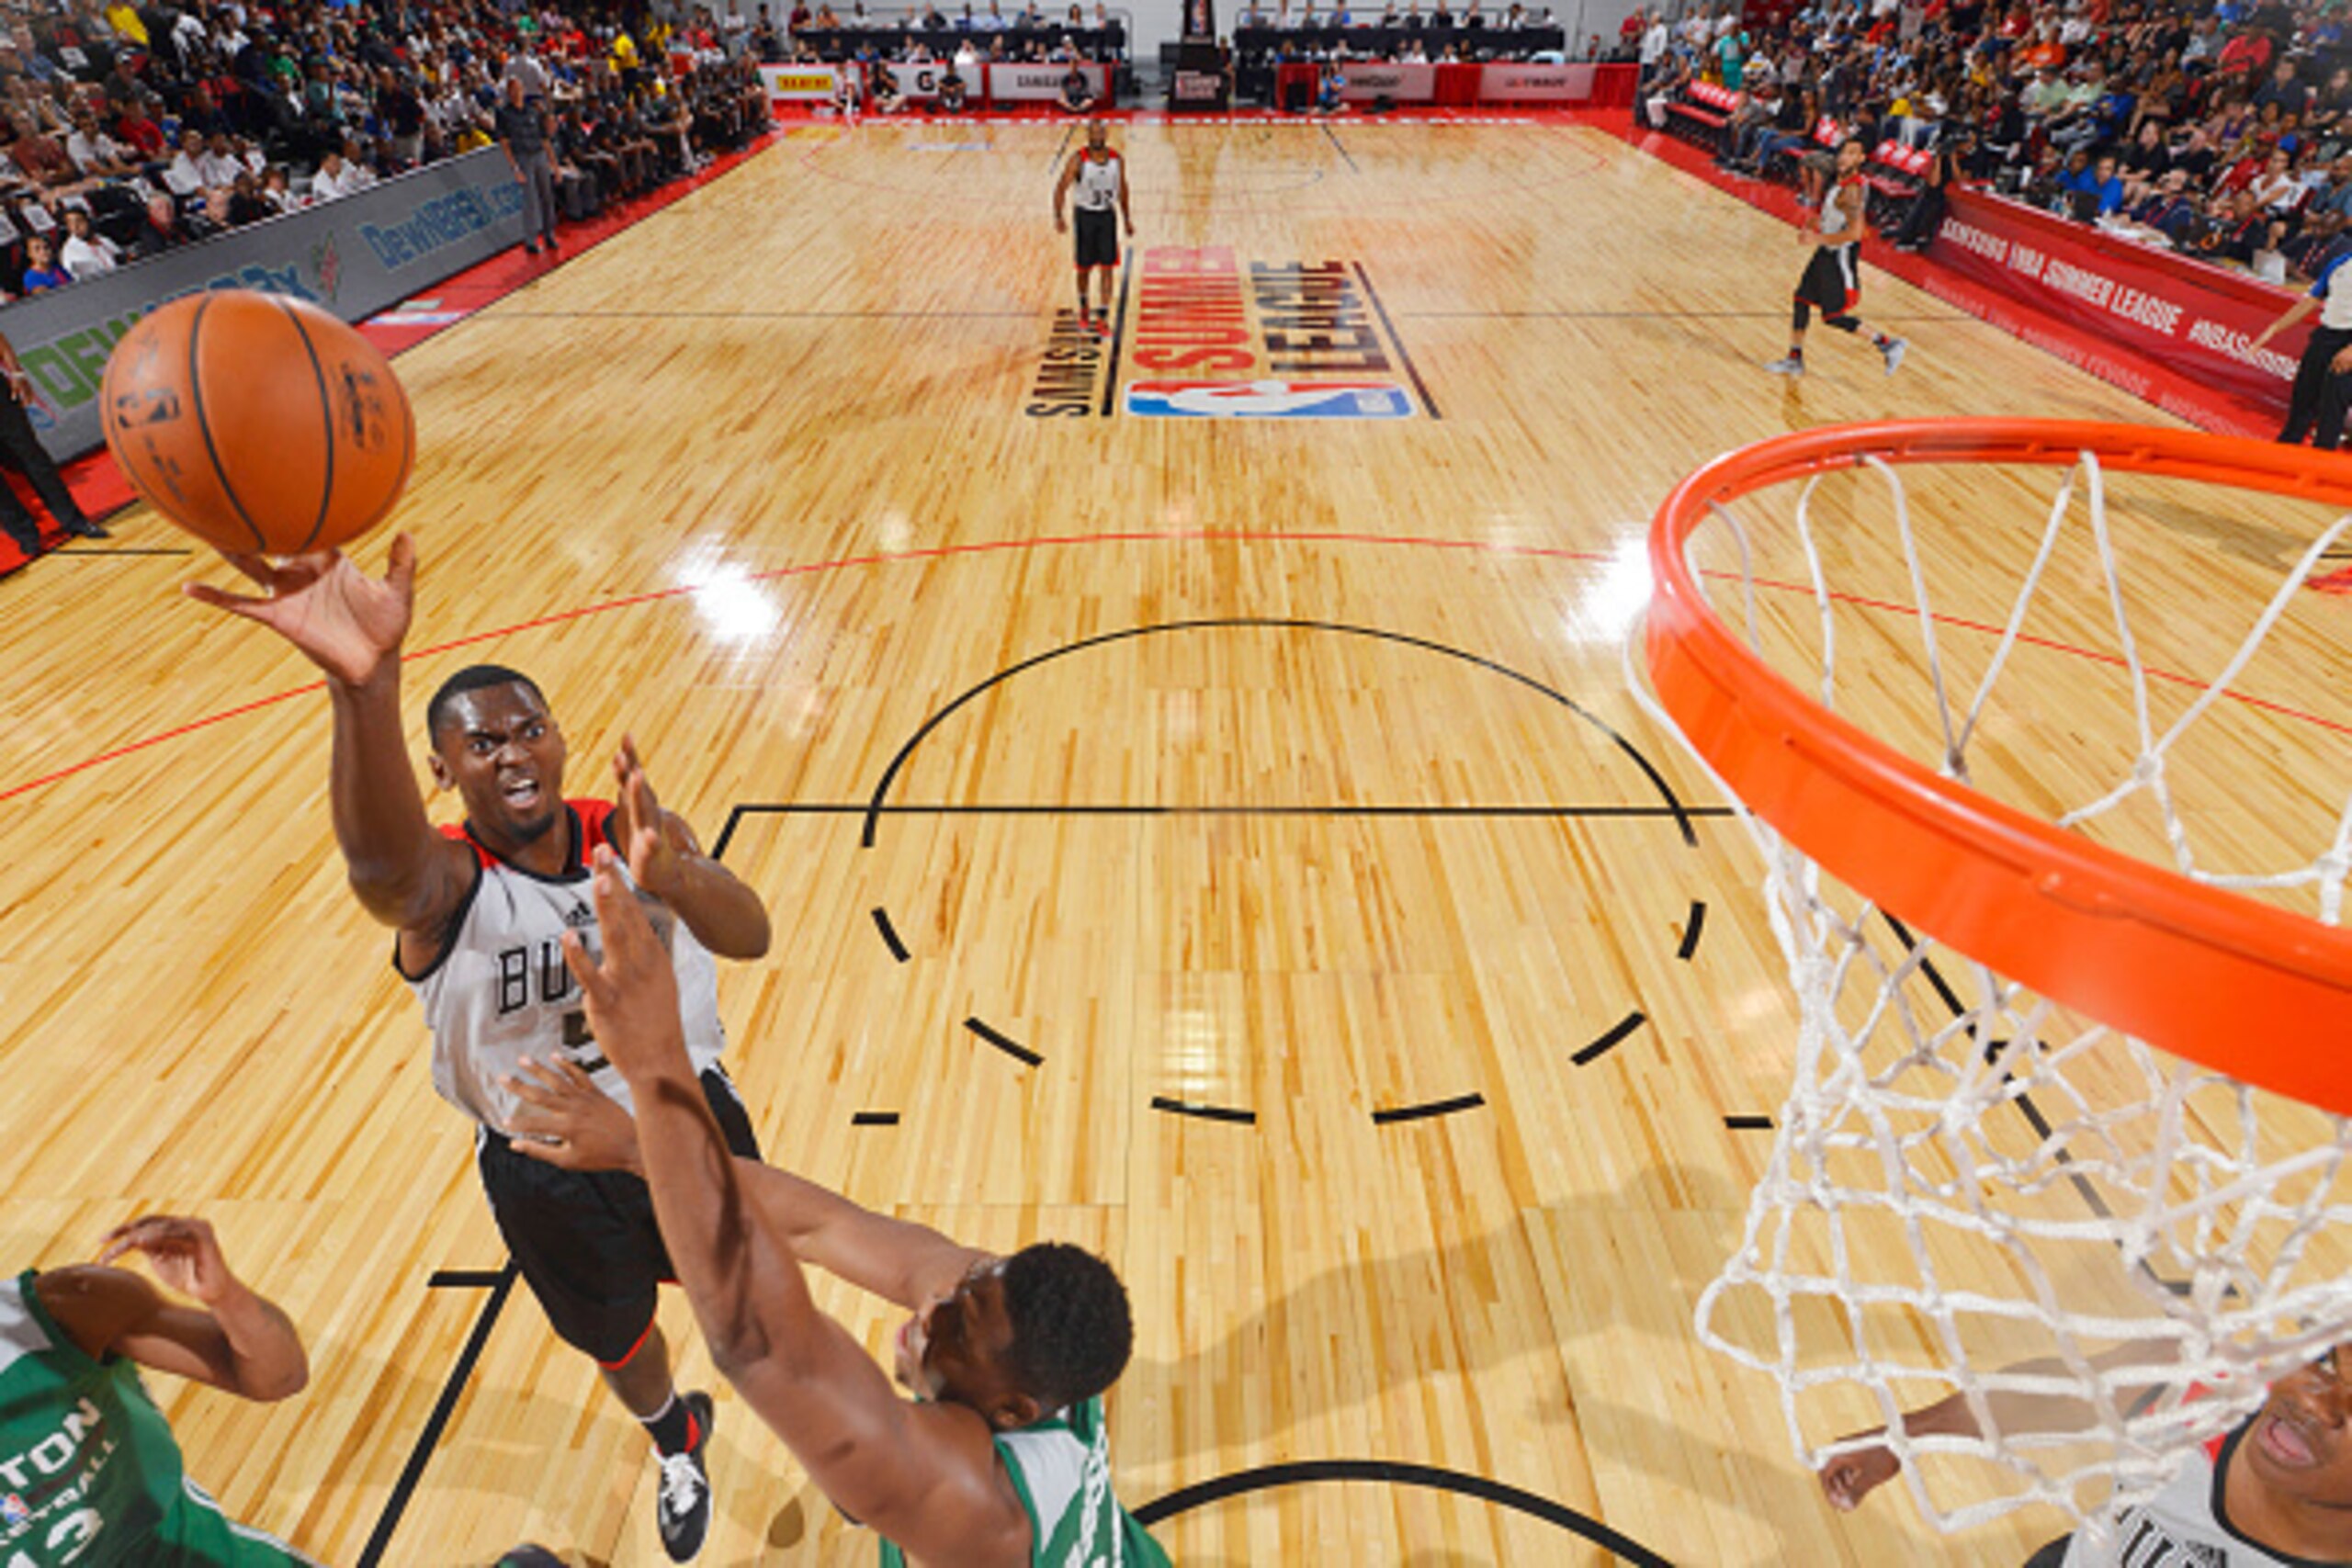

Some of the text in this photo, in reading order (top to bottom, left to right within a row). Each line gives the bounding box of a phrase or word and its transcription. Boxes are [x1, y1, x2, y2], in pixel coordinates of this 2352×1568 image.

[1132, 244, 1255, 371] SUMMER
[1250, 260, 1391, 372] LEAGUE
[1940, 217, 2008, 264] SAMSUNG
[2042, 258, 2115, 308] SUMMER
[2110, 285, 2184, 336] LEAGUE
